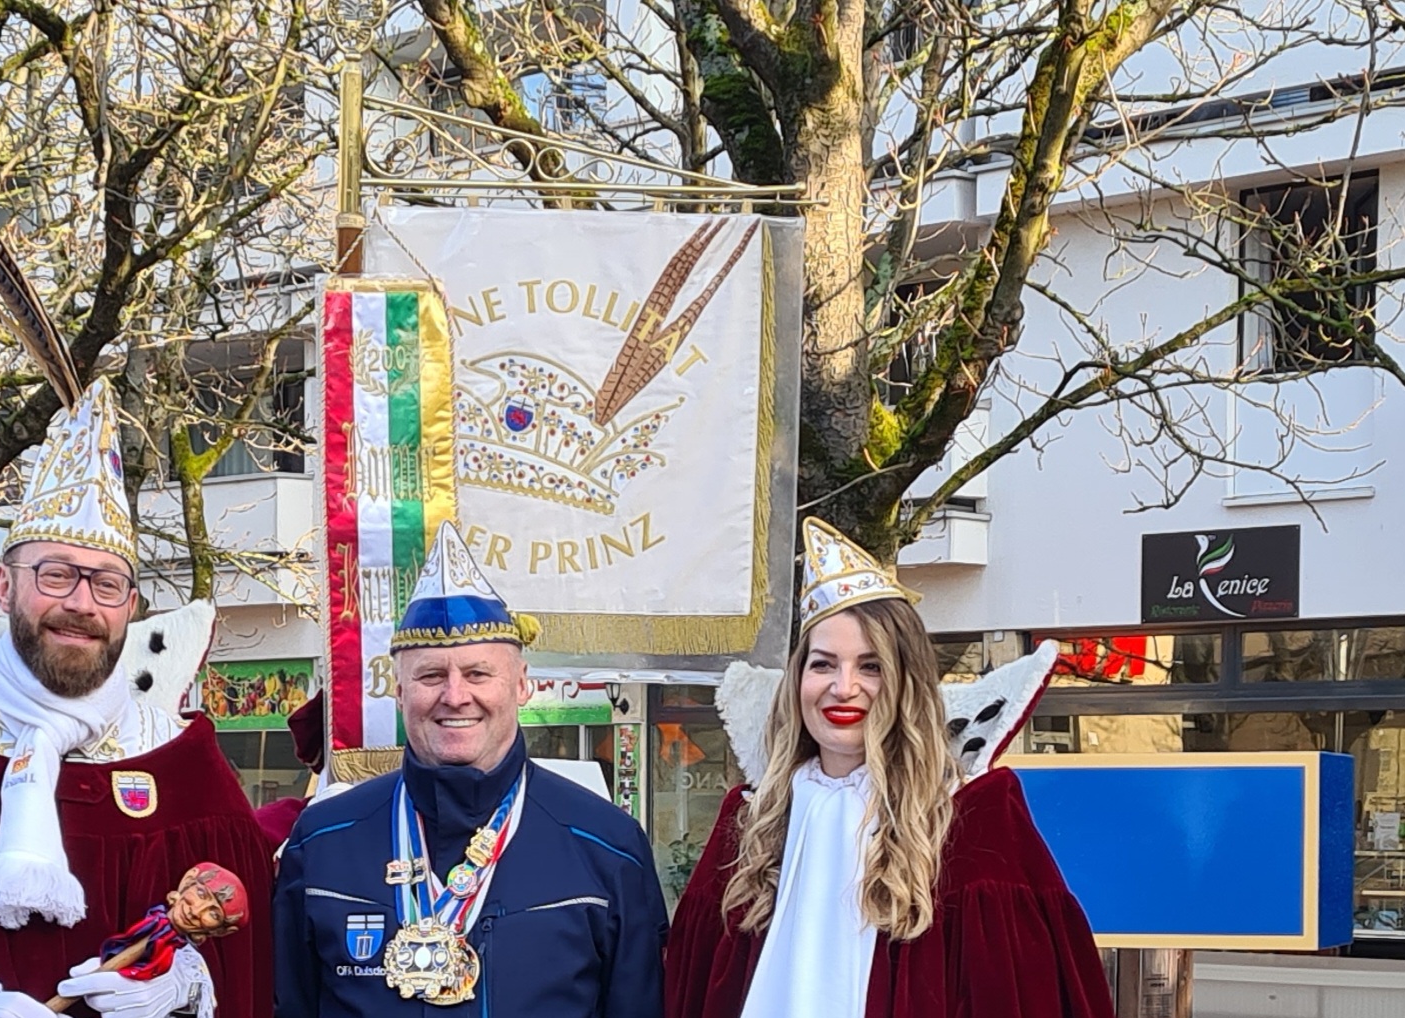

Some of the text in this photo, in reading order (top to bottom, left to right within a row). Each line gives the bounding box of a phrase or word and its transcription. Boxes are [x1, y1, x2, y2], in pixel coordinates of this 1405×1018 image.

[449, 287, 506, 337] NE
[367, 342, 408, 372] 200
[466, 512, 666, 575] ER PRINZ
[1167, 576, 1194, 599] La
